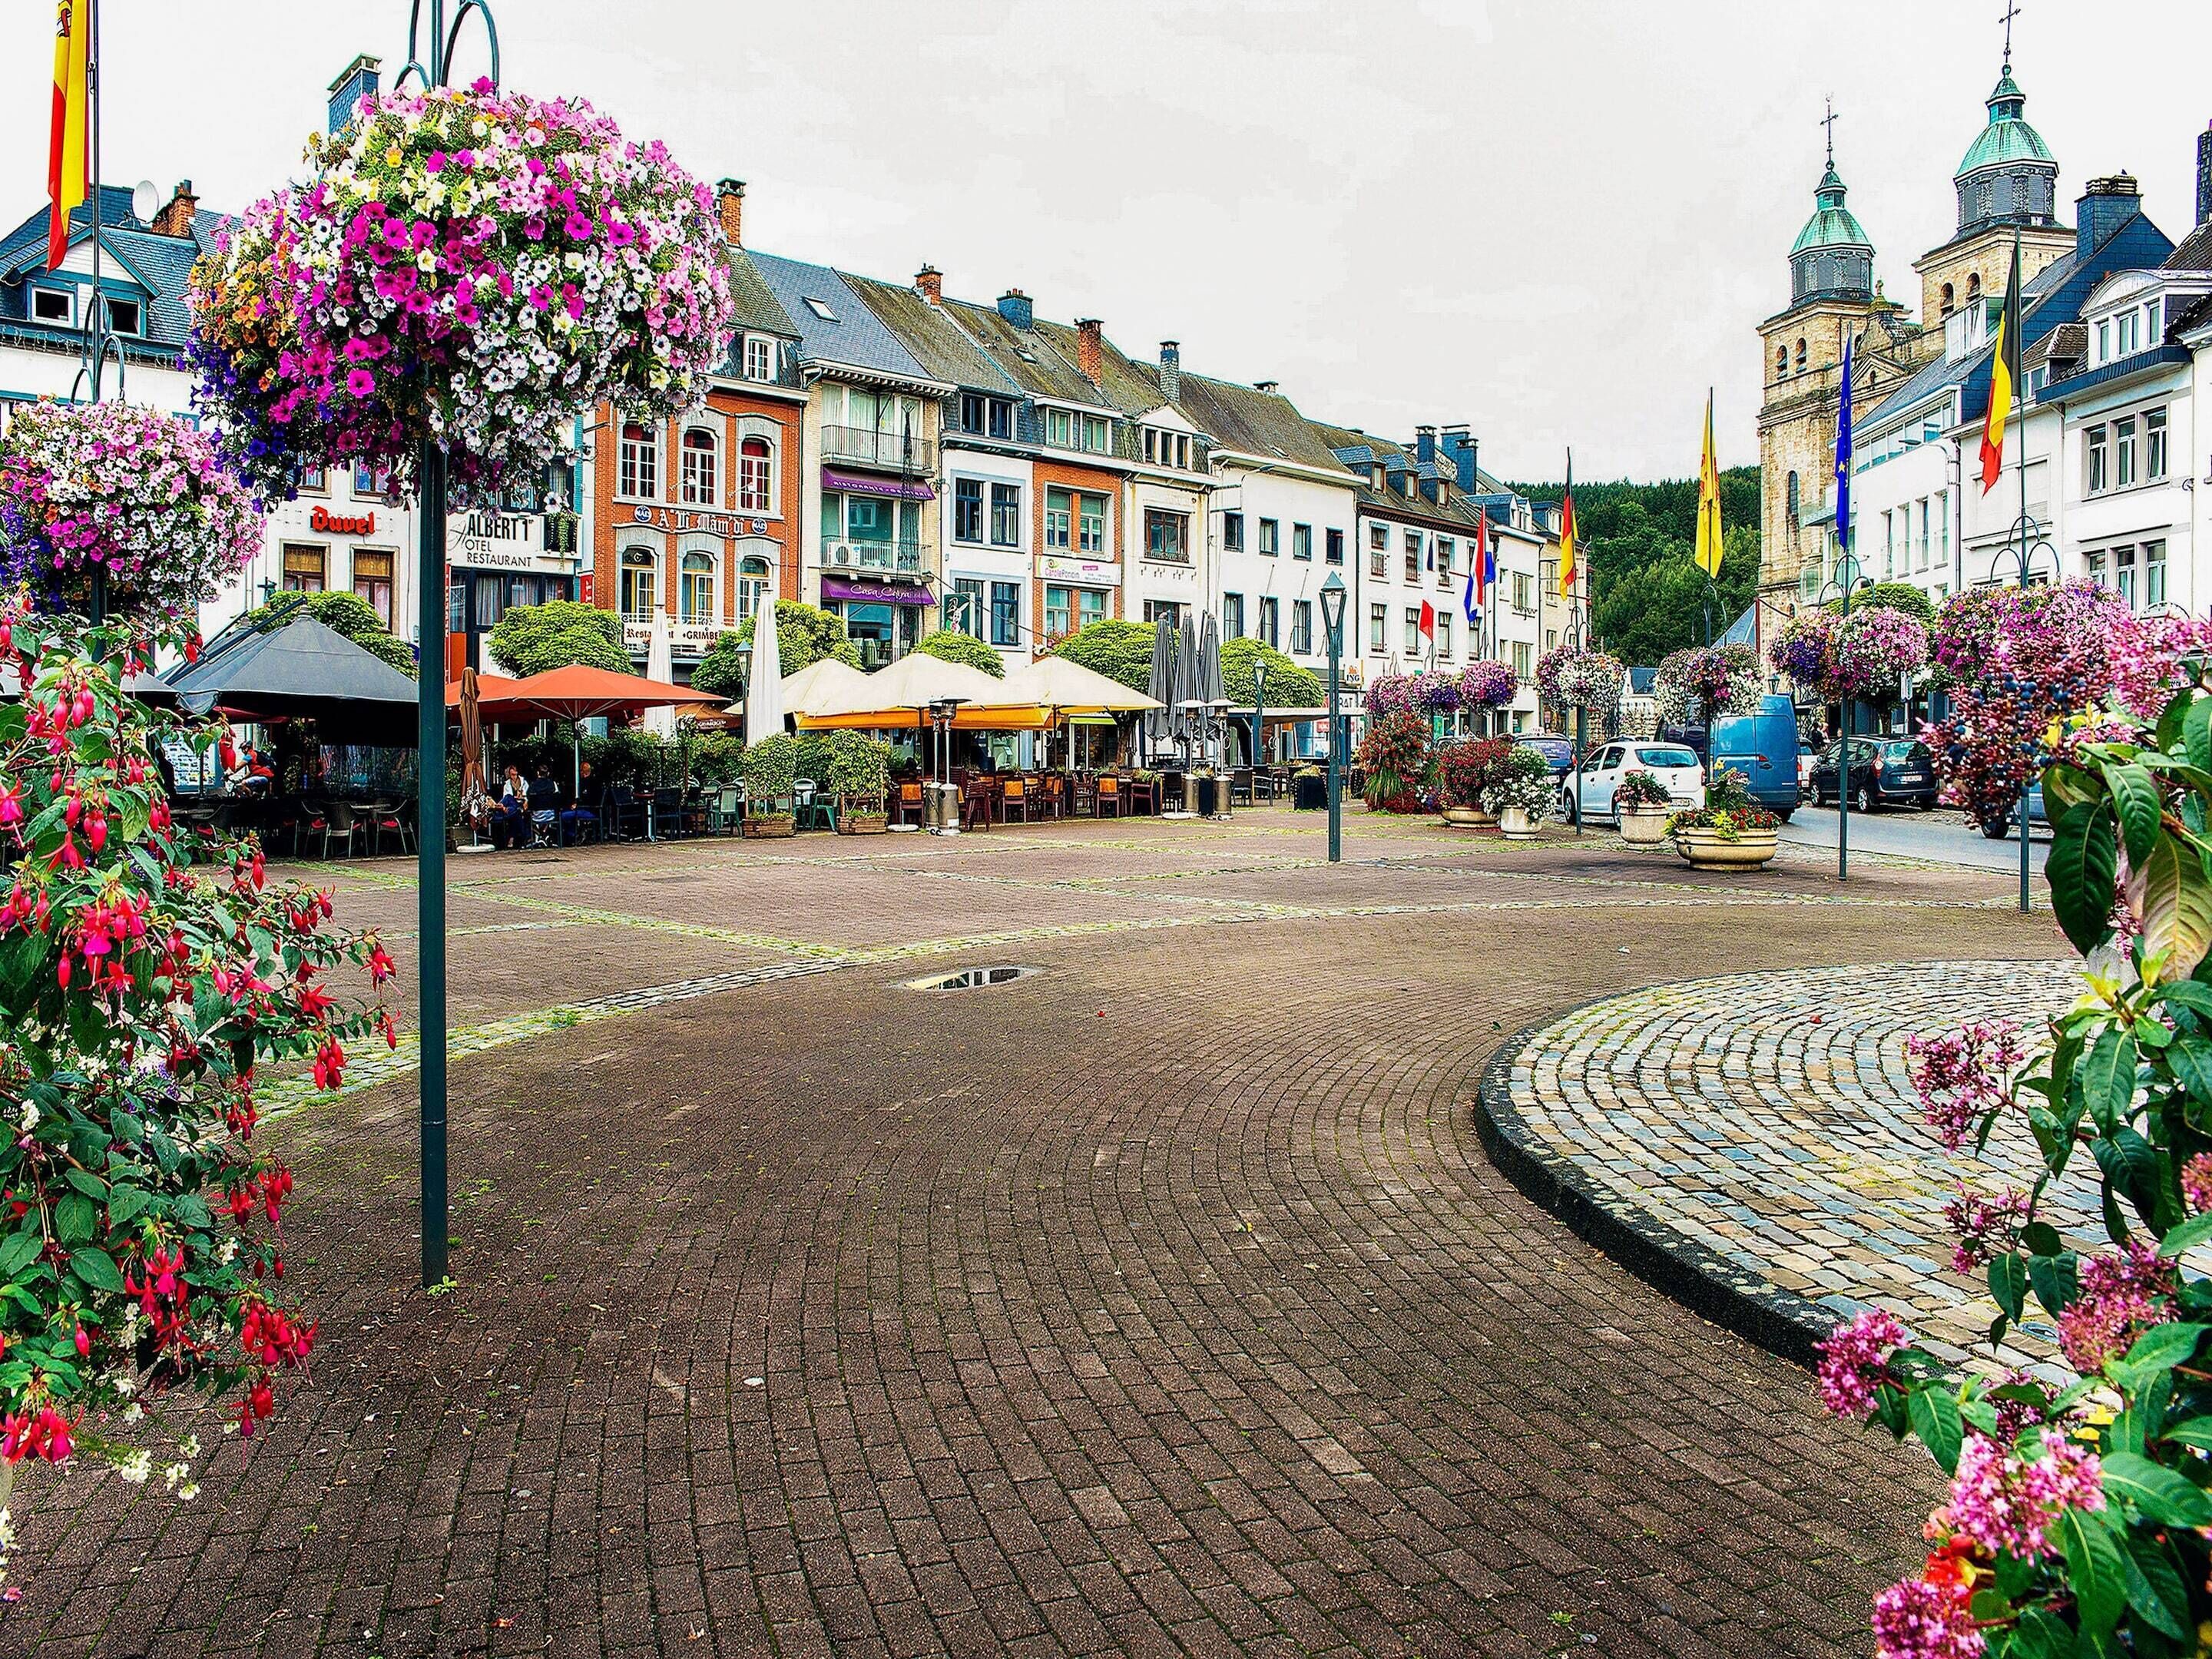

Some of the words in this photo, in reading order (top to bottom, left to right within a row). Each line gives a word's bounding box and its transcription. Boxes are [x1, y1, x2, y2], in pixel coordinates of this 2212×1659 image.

[312, 505, 376, 535] Duvel
[468, 513, 518, 541] ALBERT
[467, 552, 532, 568] RESTAURANT
[850, 584, 882, 598] Casa
[626, 628, 674, 639] Restat
